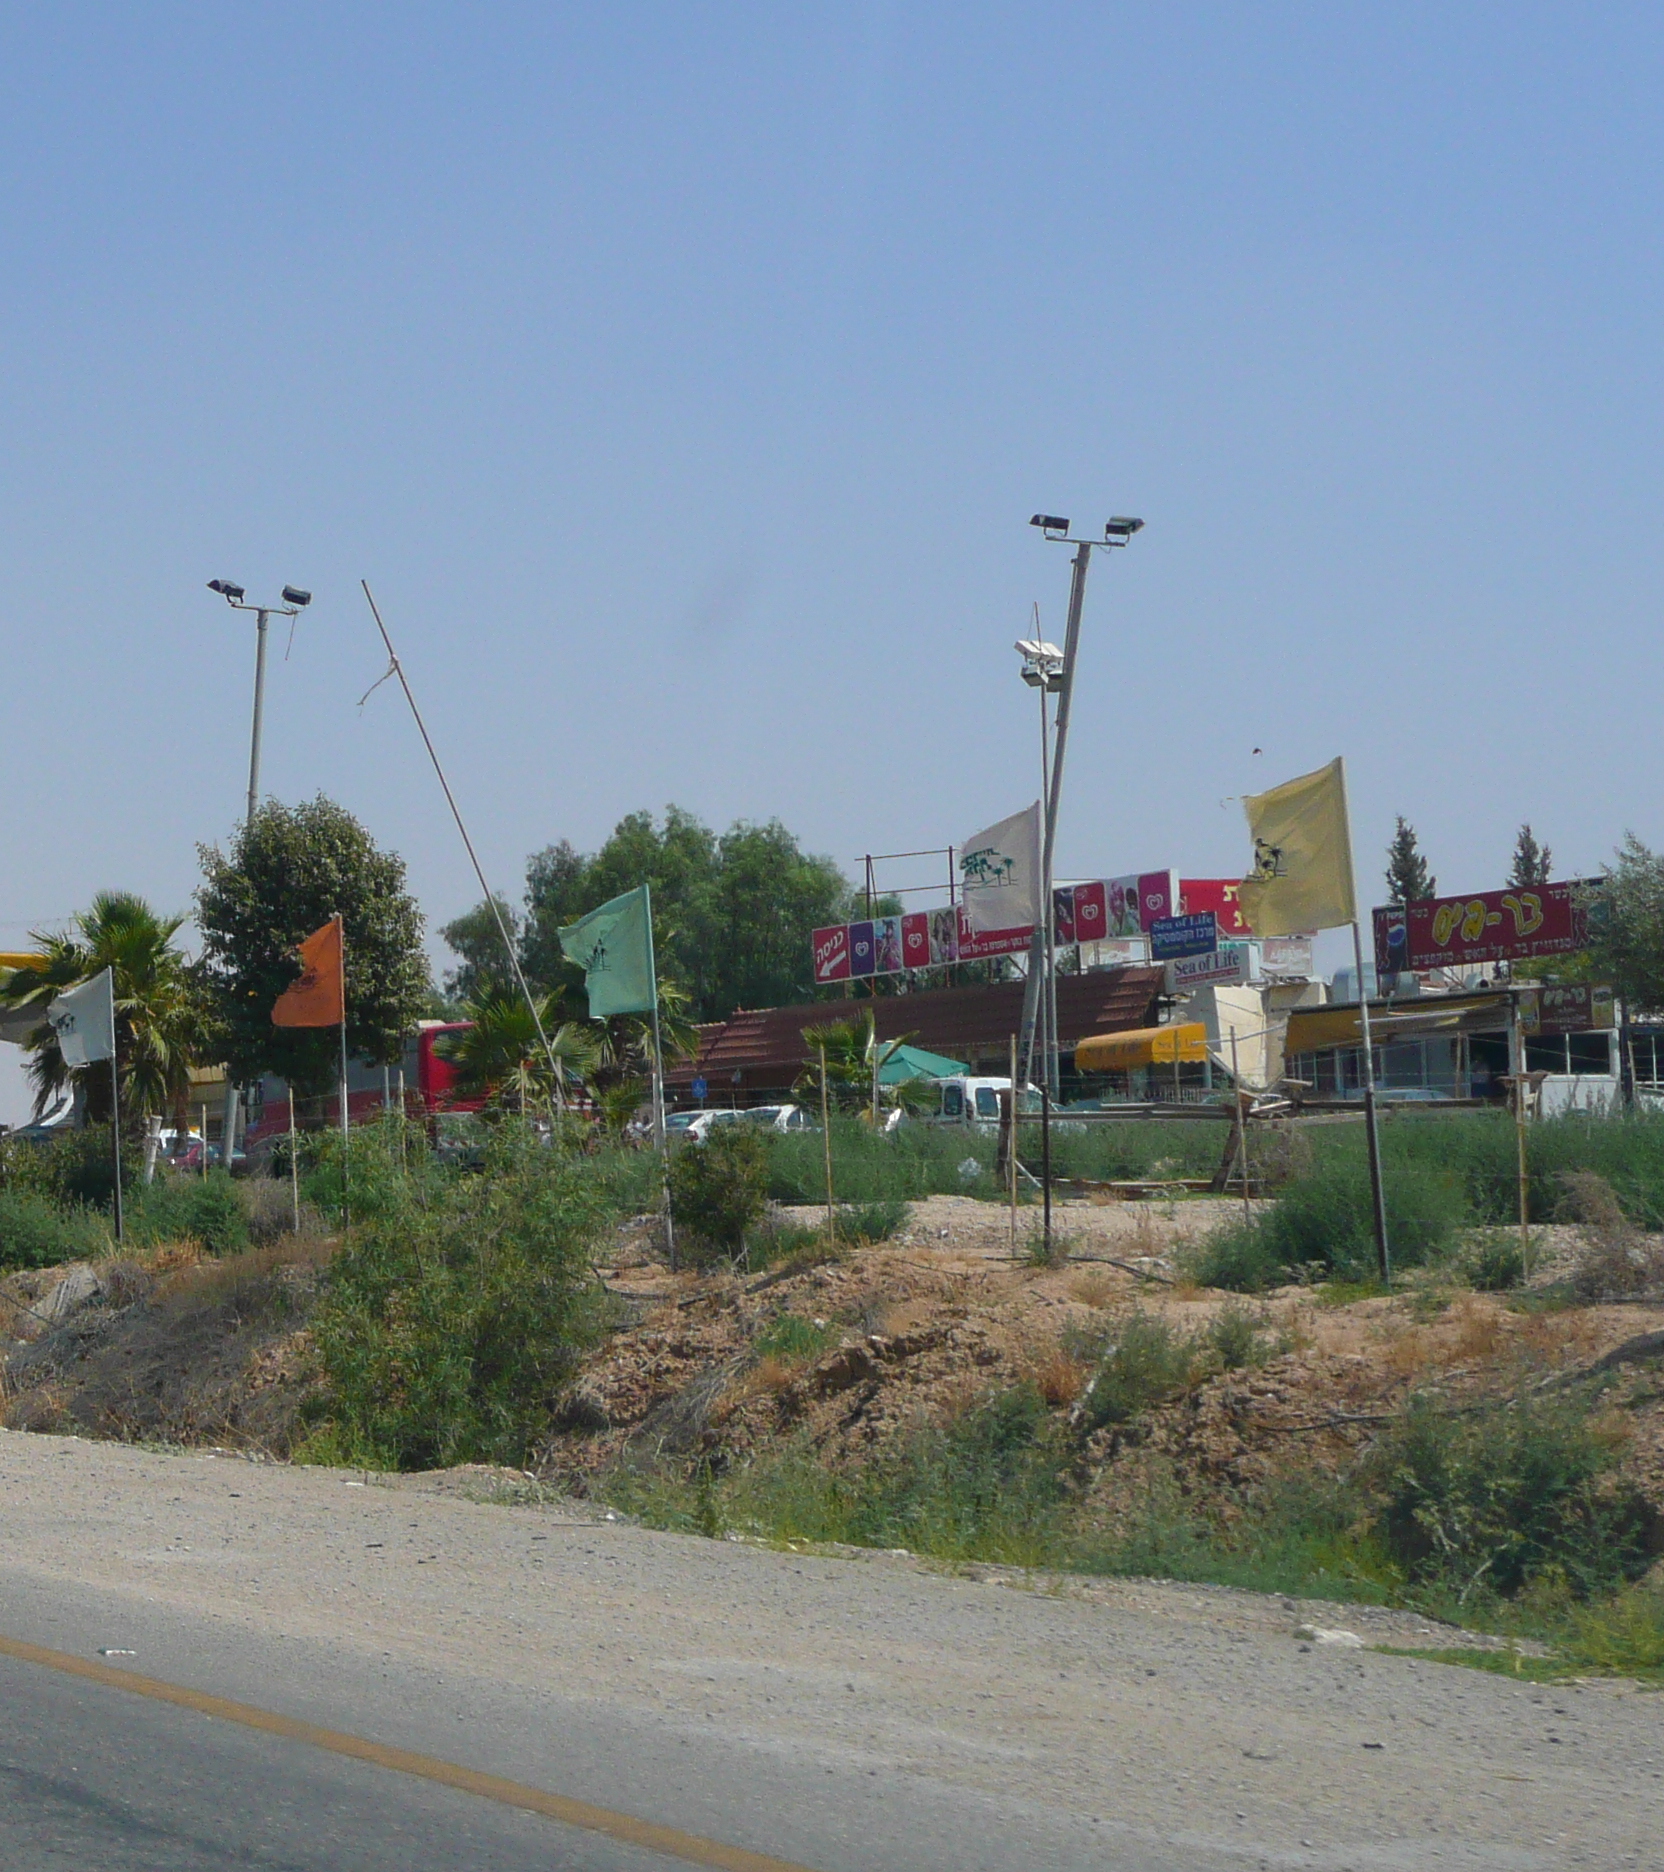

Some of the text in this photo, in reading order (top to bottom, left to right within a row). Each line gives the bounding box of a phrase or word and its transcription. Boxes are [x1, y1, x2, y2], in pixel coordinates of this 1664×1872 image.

[816, 931, 844, 964] כניסה
[1174, 960, 1196, 976] Sea
[1198, 954, 1212, 972] of
[1214, 949, 1239, 969] Life
